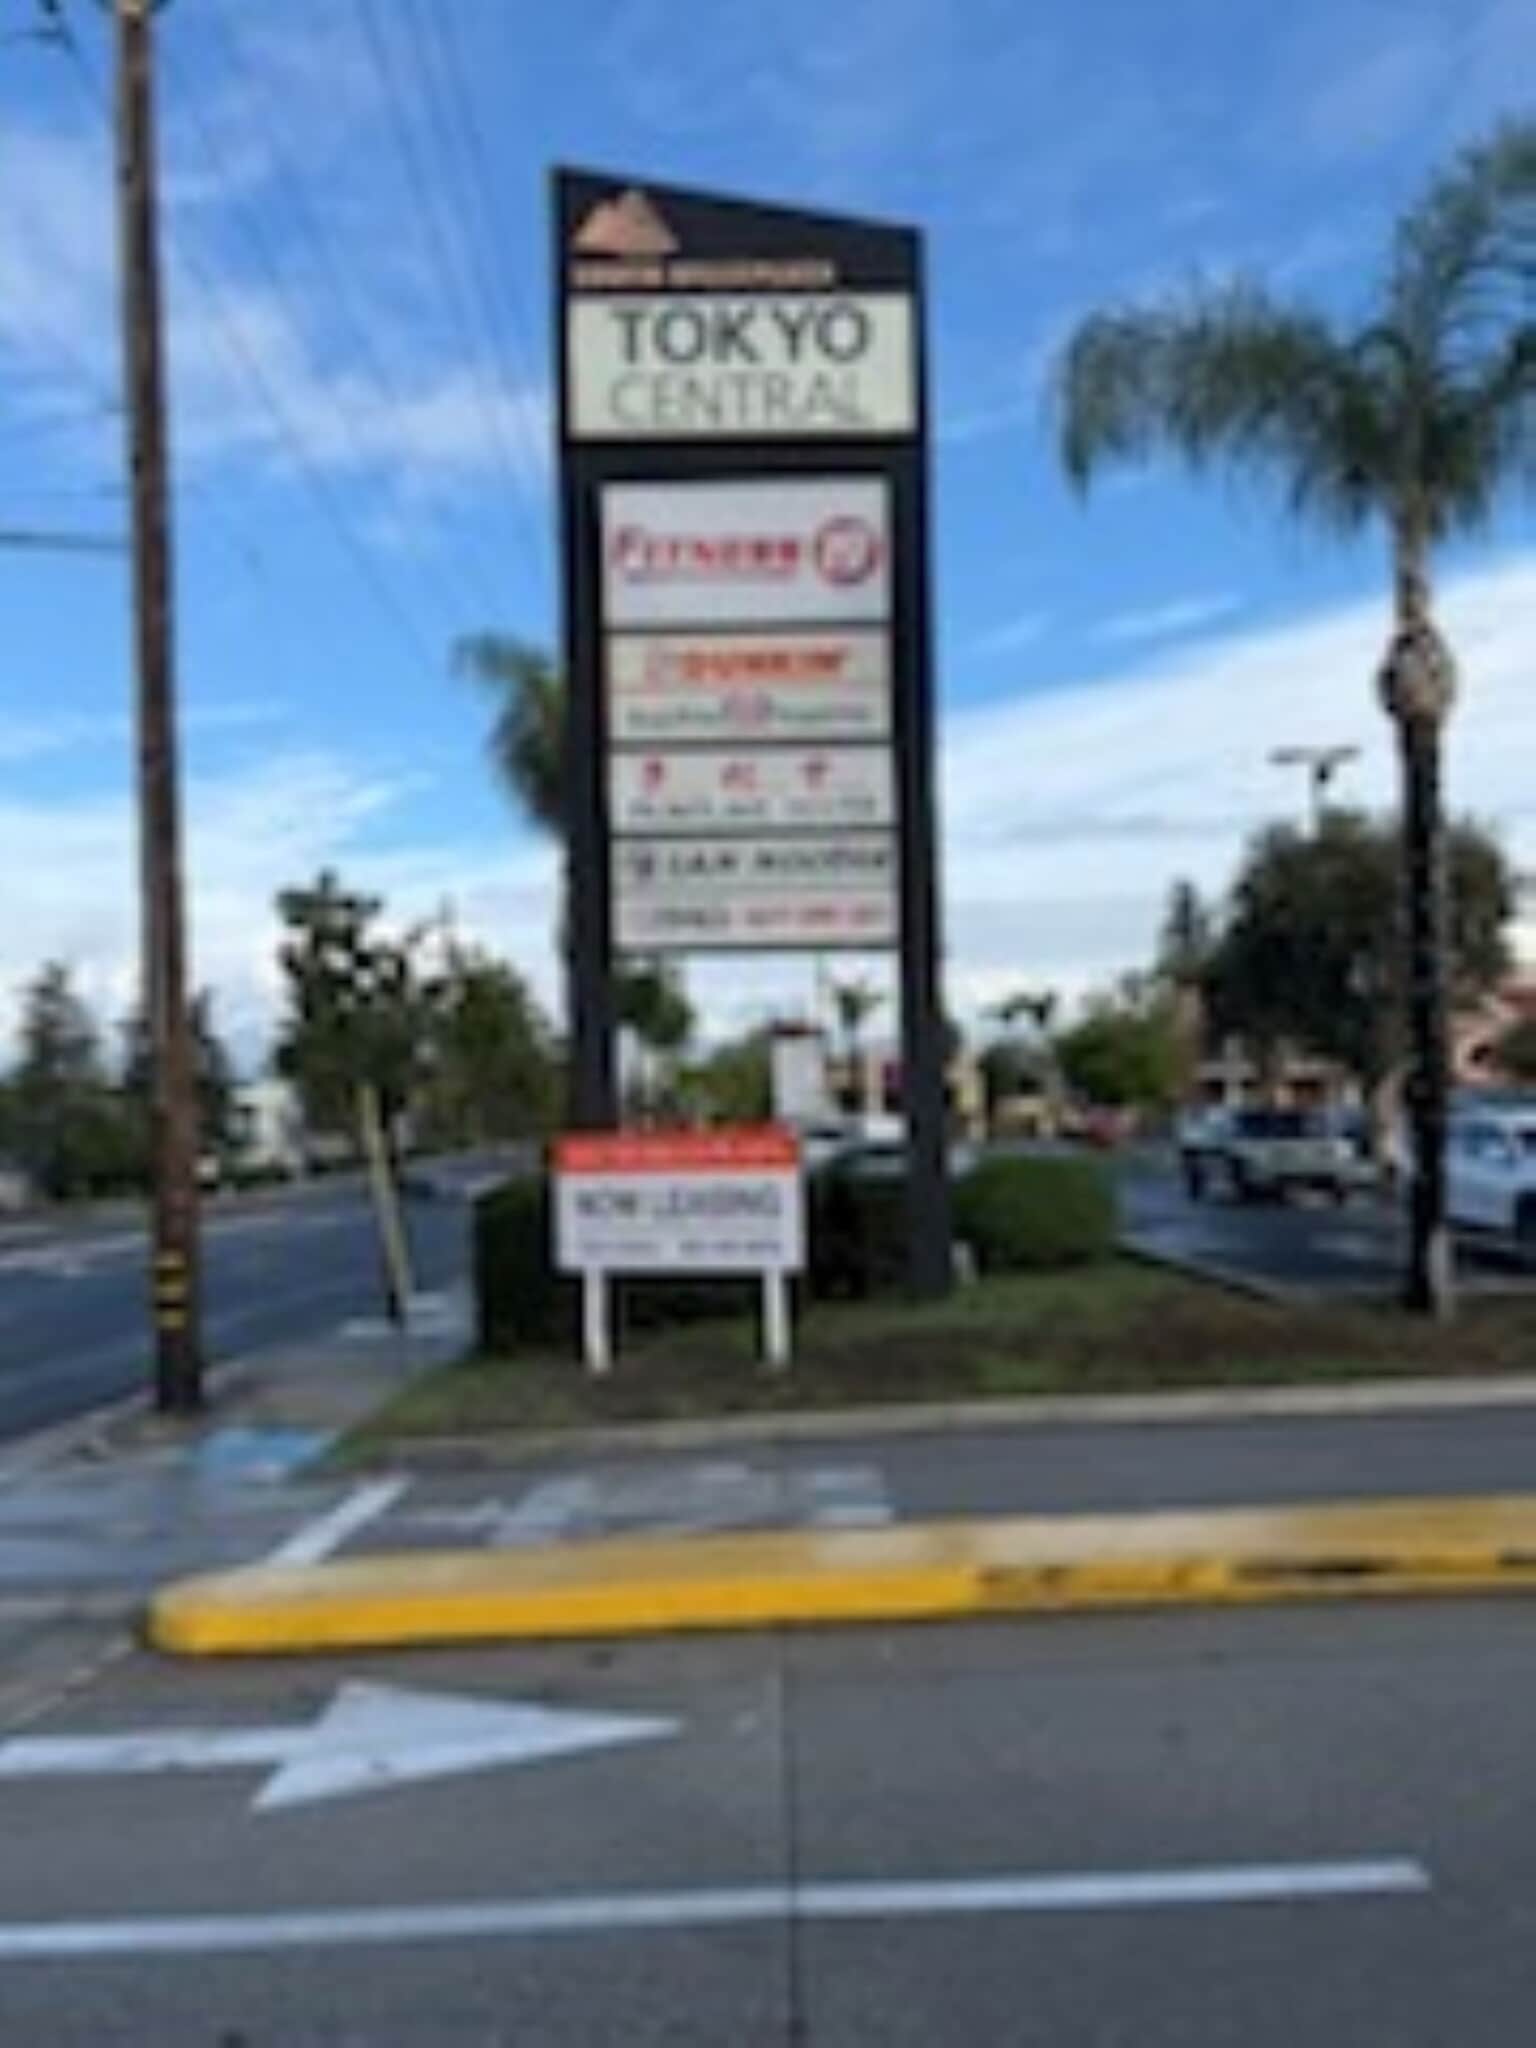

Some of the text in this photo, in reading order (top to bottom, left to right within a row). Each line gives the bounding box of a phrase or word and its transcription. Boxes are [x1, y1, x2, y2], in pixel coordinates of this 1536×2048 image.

[609, 302, 870, 364] TOKYO
[609, 371, 873, 425] CENTRAL
[611, 525, 800, 574] FITNE
